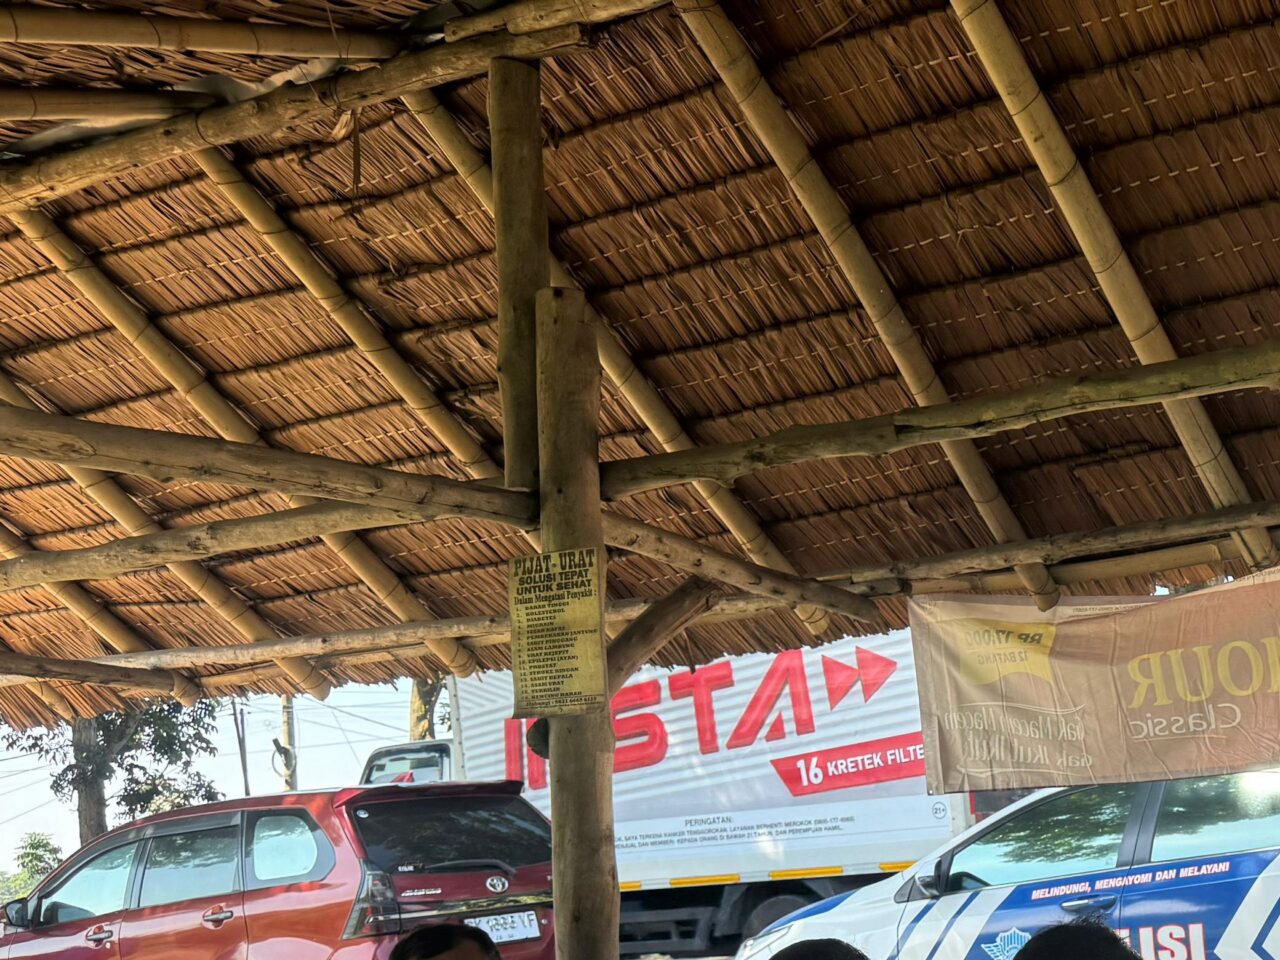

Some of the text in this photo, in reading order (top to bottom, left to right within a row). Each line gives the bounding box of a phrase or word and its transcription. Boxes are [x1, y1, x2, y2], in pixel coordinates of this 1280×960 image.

[559, 548, 595, 571] URAT
[516, 579, 592, 596] UNTUK SEHAT
[518, 569, 589, 586] SOLUSI TEPAT
[796, 744, 925, 787] 16 KRETEK FILTE
[684, 815, 734, 827] PERINGATAN:
[1031, 861, 1230, 900] MELINDUNGI, MENGAYOMI DAN MELAYANI
